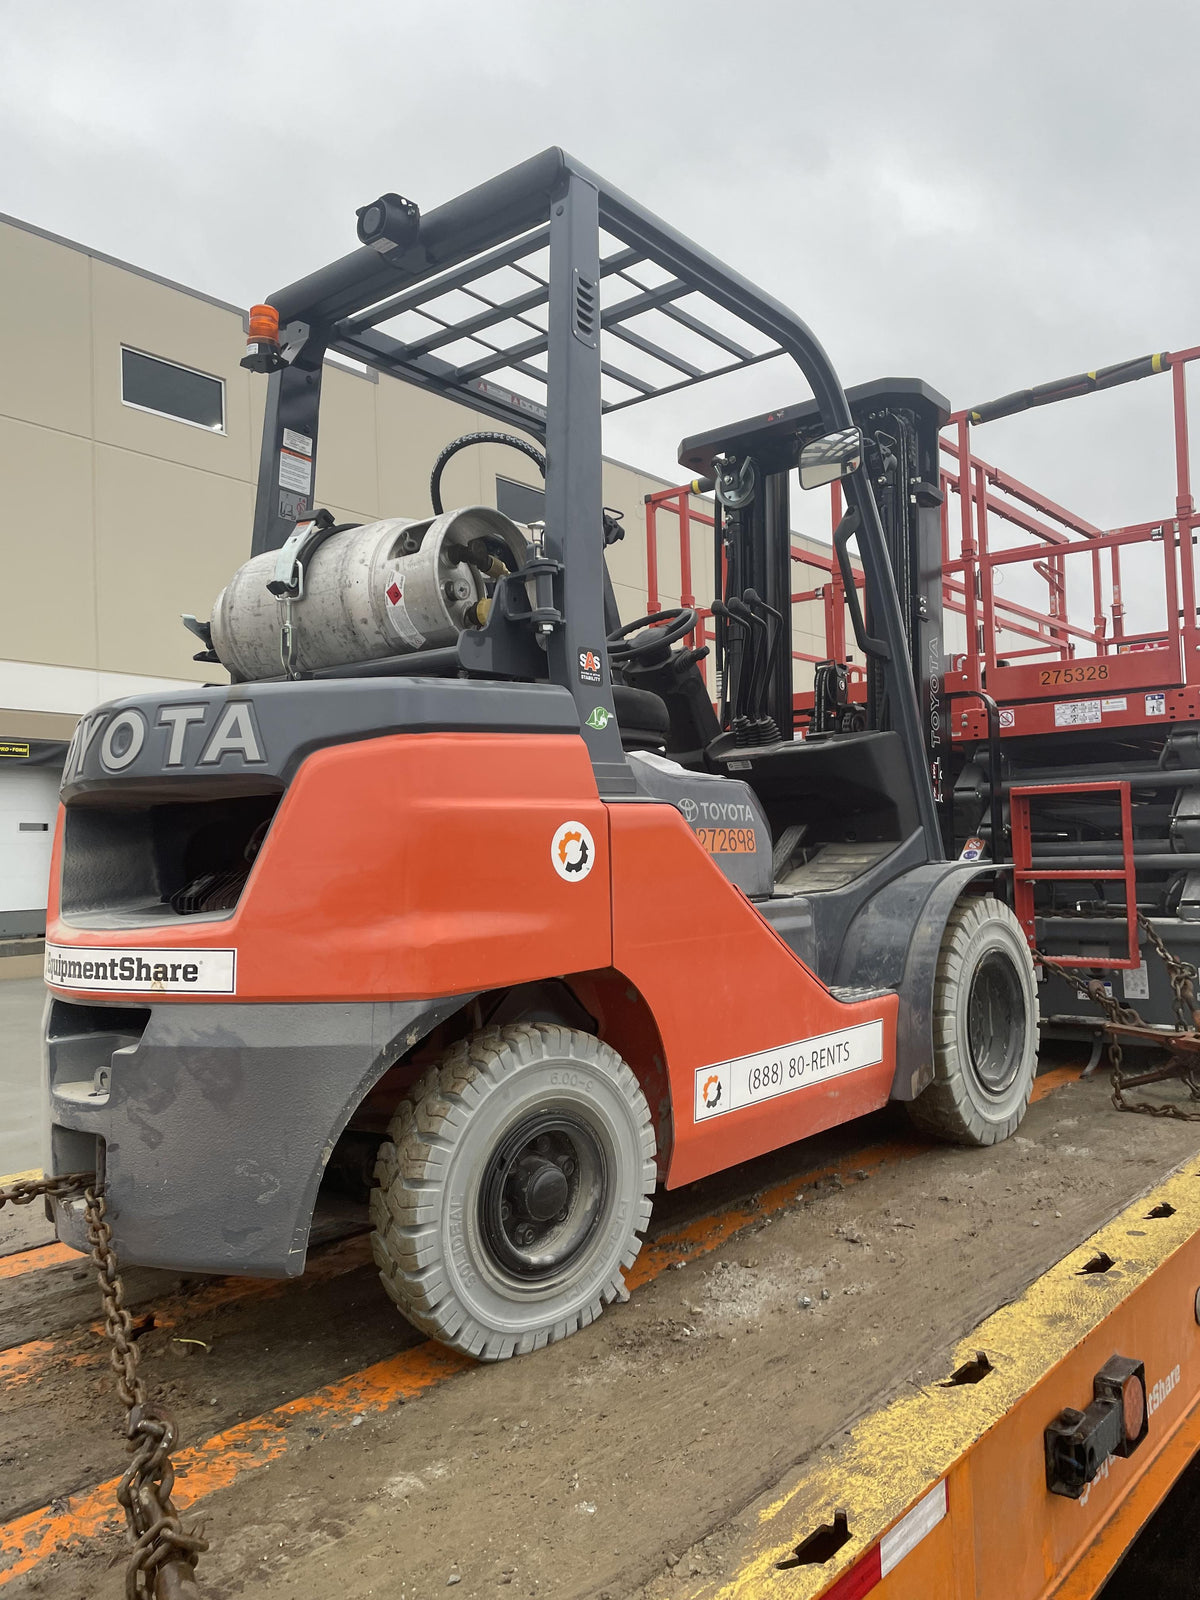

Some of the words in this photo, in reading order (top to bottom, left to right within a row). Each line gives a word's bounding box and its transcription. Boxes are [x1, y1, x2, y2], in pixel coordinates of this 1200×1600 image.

[580, 651, 600, 671] SAS
[1041, 665, 1108, 685] 275328
[929, 637, 940, 748] TOYOTA
[62, 703, 261, 785] YOTA
[700, 802, 754, 822] TOYOTA
[698, 828, 755, 852] 272698
[748, 1060, 783, 1094] (888)
[789, 1041, 850, 1079] 80-RENTS
[550, 1072, 593, 1093] 6.00-9
[449, 1201, 478, 1290] SOLIDEAL
